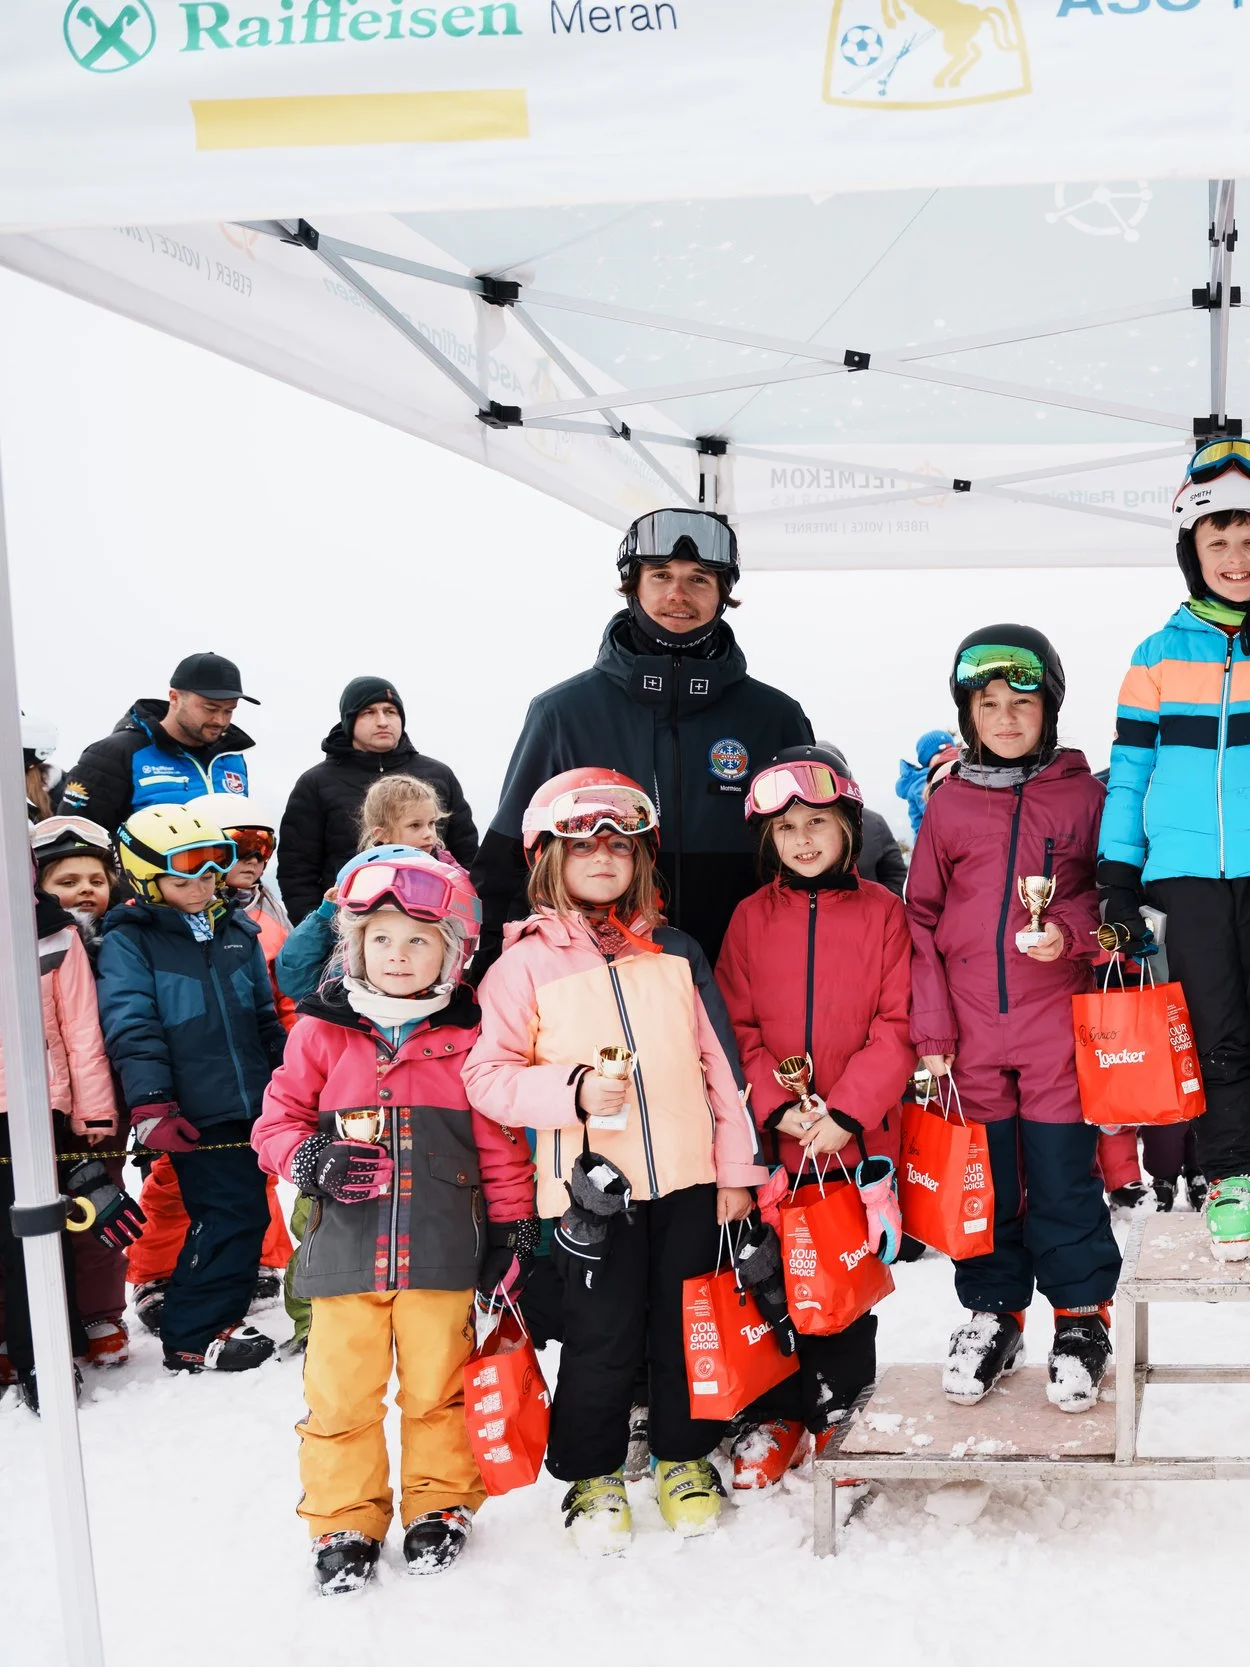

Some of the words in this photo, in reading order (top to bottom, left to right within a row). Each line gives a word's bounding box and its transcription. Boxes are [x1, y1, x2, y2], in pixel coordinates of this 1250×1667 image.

[179, 0, 523, 51] Raiffeisen
[551, 0, 678, 33] Meran
[1190, 489, 1212, 502] SMITH
[1170, 1033, 1190, 1046] GOOD
[1095, 1048, 1146, 1069] Loacker
[319, 1157, 336, 1186] LEVEL
[965, 1163, 983, 1175] OUR
[907, 1163, 939, 1192] Loacker
[964, 1173, 984, 1183] OOD
[964, 1181, 985, 1191] HOICE
[791, 1249, 817, 1260] YOUR
[840, 1240, 870, 1271] Loack
[789, 1259, 816, 1269] GOOD
[790, 1268, 815, 1277] CHOICE
[691, 1322, 717, 1333] YOUR
[740, 1321, 774, 1345] Loac
[690, 1333, 718, 1343] GOOD
[690, 1341, 719, 1351] CHOICE
